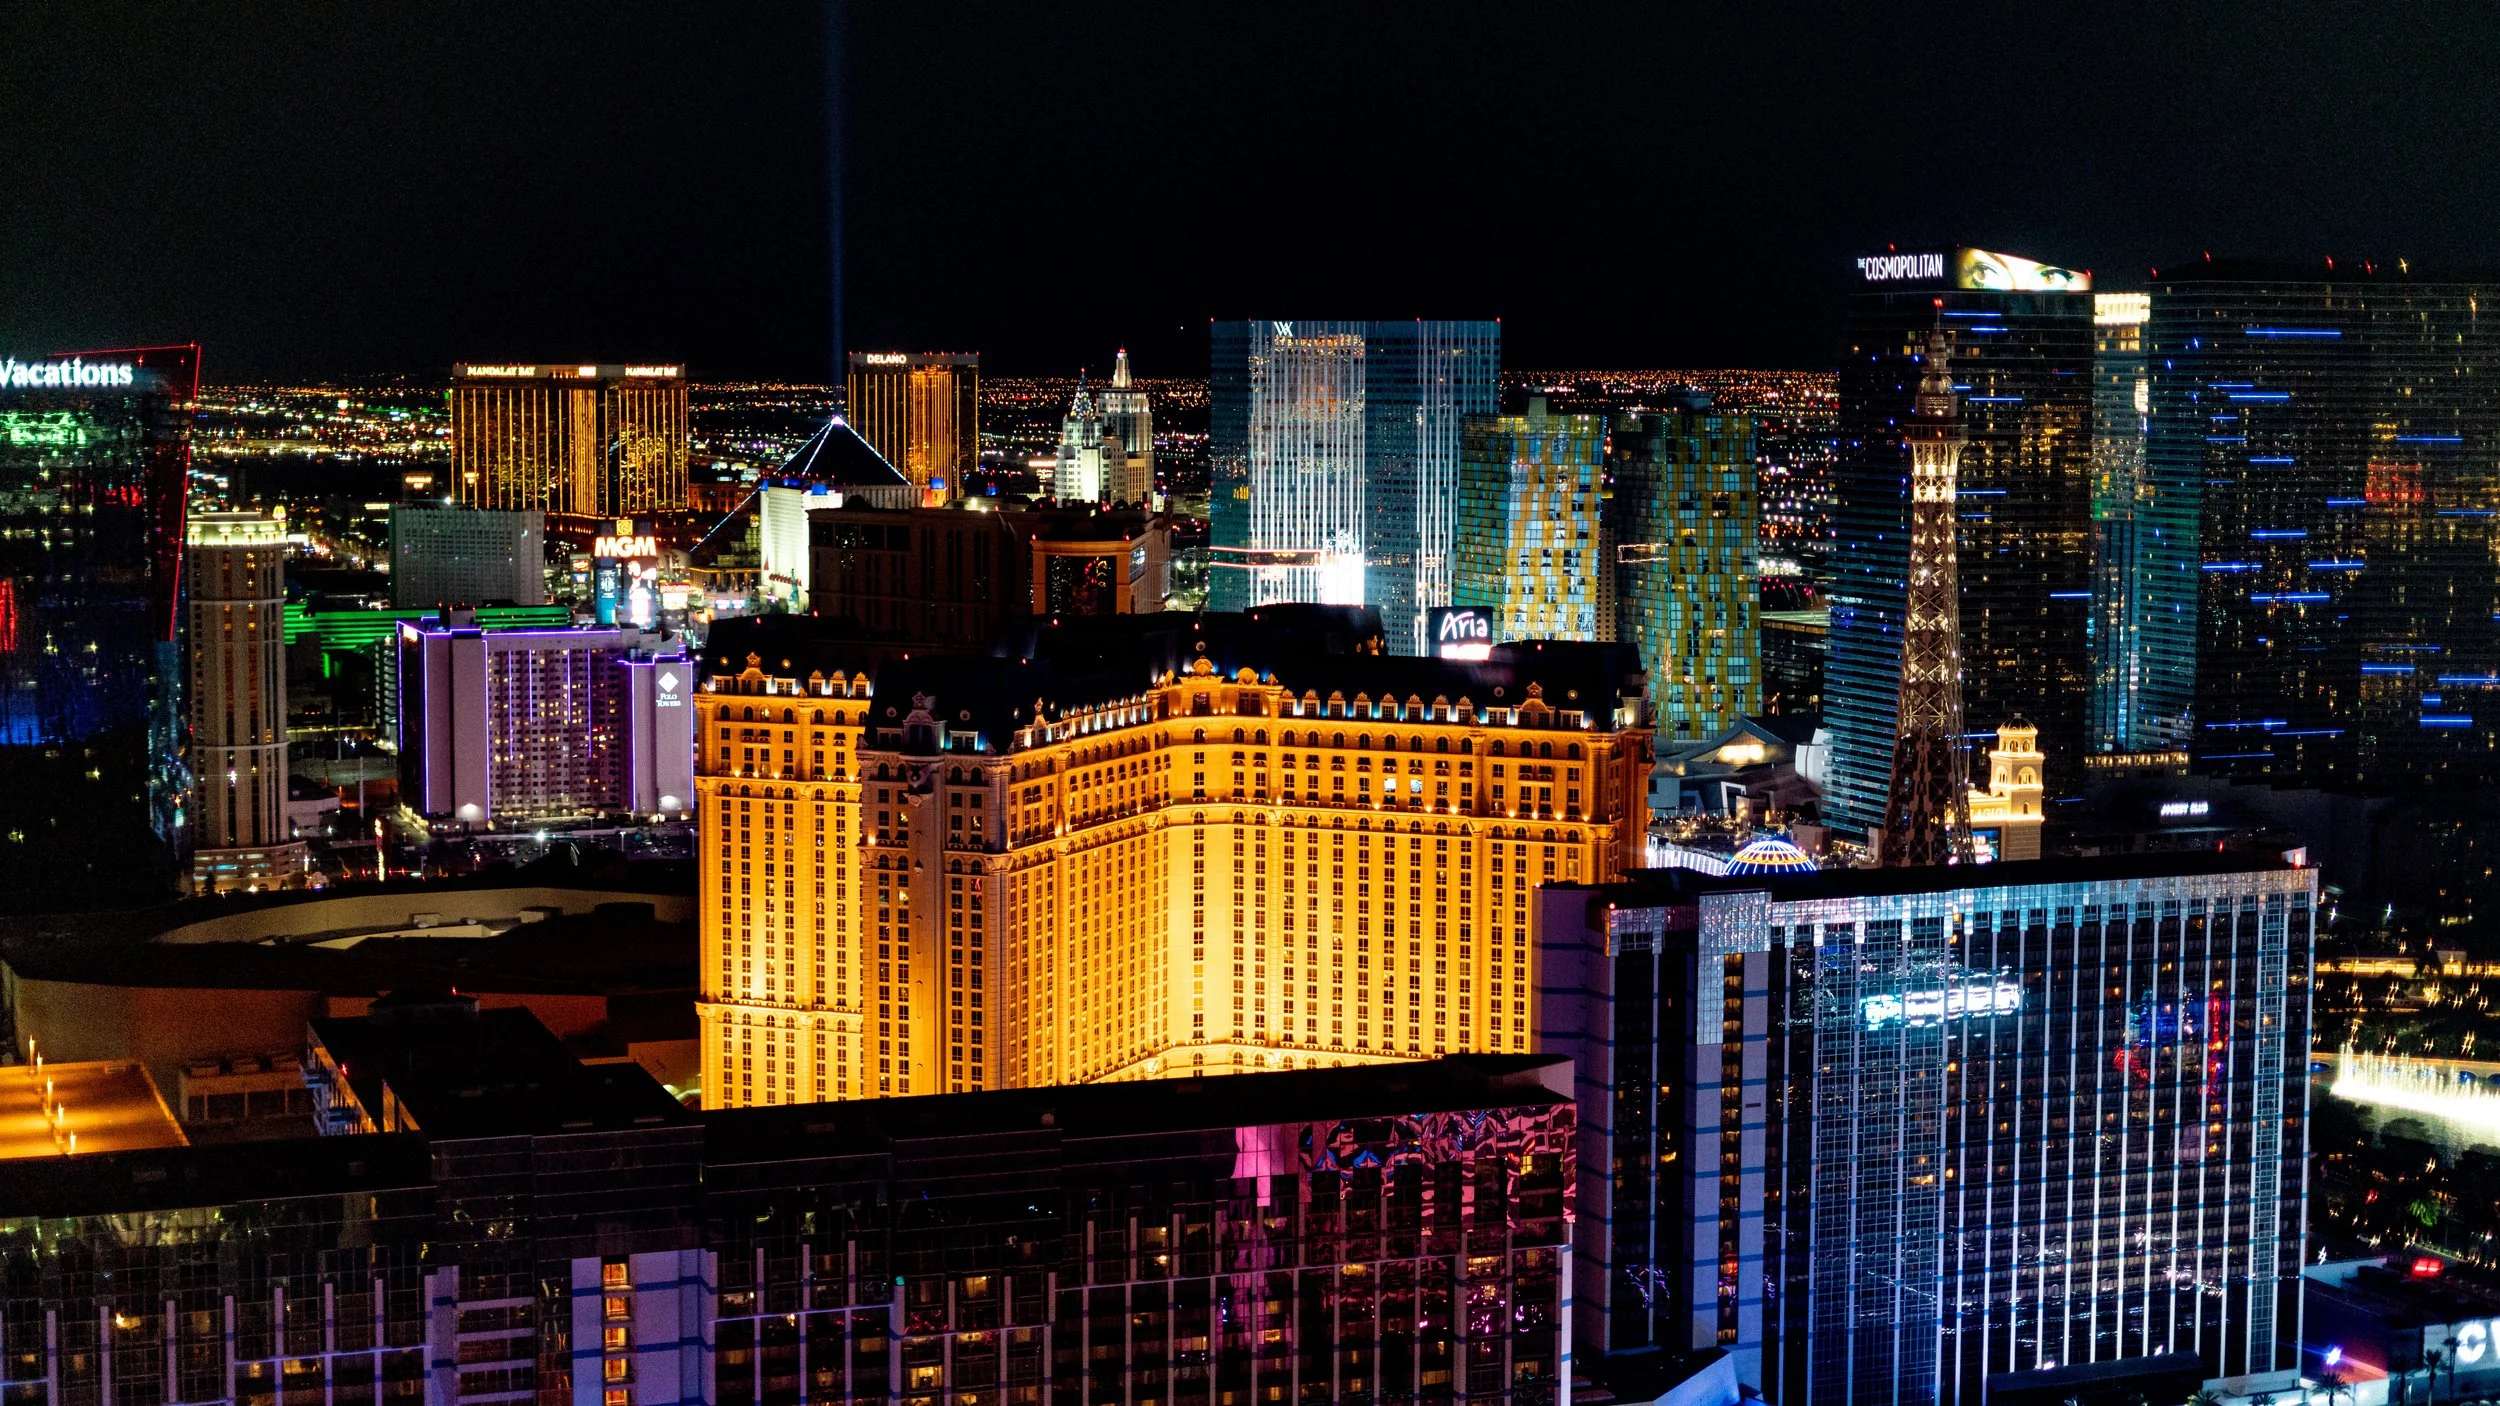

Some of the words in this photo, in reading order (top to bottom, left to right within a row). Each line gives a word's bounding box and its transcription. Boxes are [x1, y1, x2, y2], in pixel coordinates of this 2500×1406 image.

[1865, 254, 1943, 280] COSMOPOLITAN
[467, 366, 517, 376] MANDALAY
[866, 354, 907, 364] DELANO
[0, 357, 133, 387] Vacations
[594, 536, 657, 558] MGM
[1440, 611, 1488, 641] Aria
